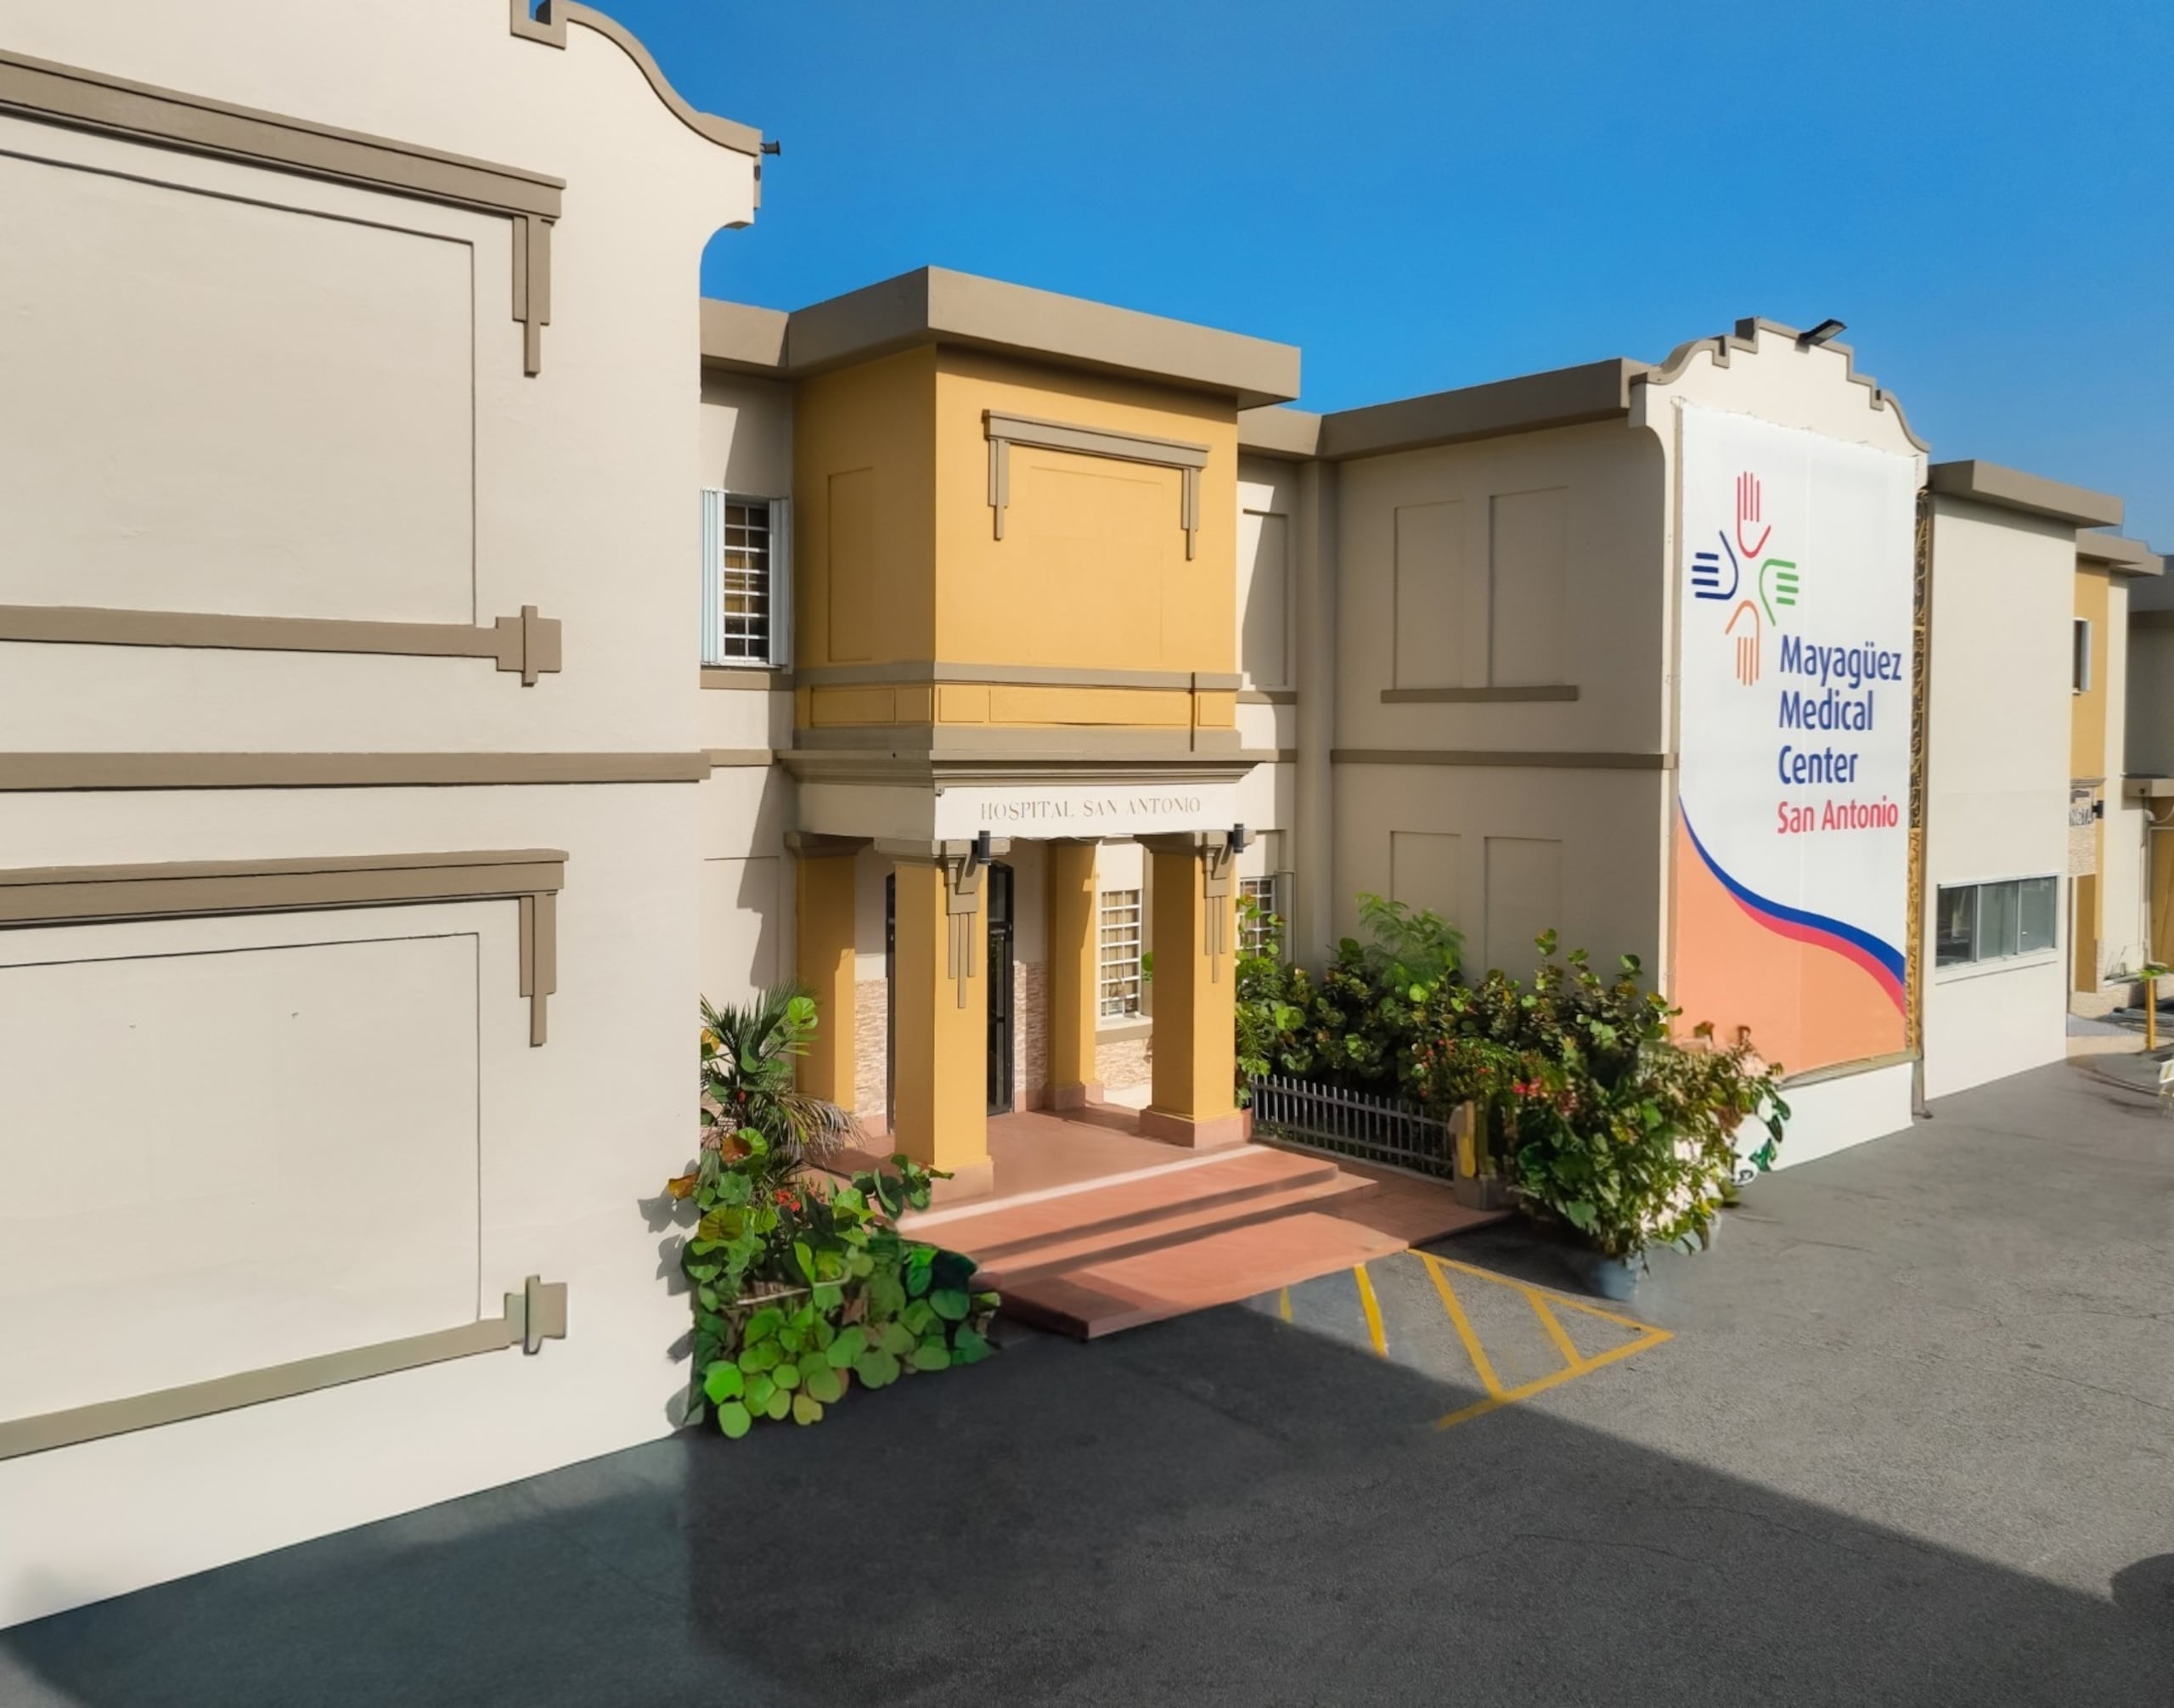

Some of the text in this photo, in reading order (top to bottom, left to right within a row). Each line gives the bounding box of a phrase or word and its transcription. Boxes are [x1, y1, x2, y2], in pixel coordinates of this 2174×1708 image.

[1779, 634, 1902, 690] Mayagüez
[1778, 687, 1873, 731] Medical
[1777, 744, 1859, 785] Center
[980, 796, 1202, 821] HOSPITAL SAN ANTONIO
[1777, 794, 1900, 834] San Antonio
